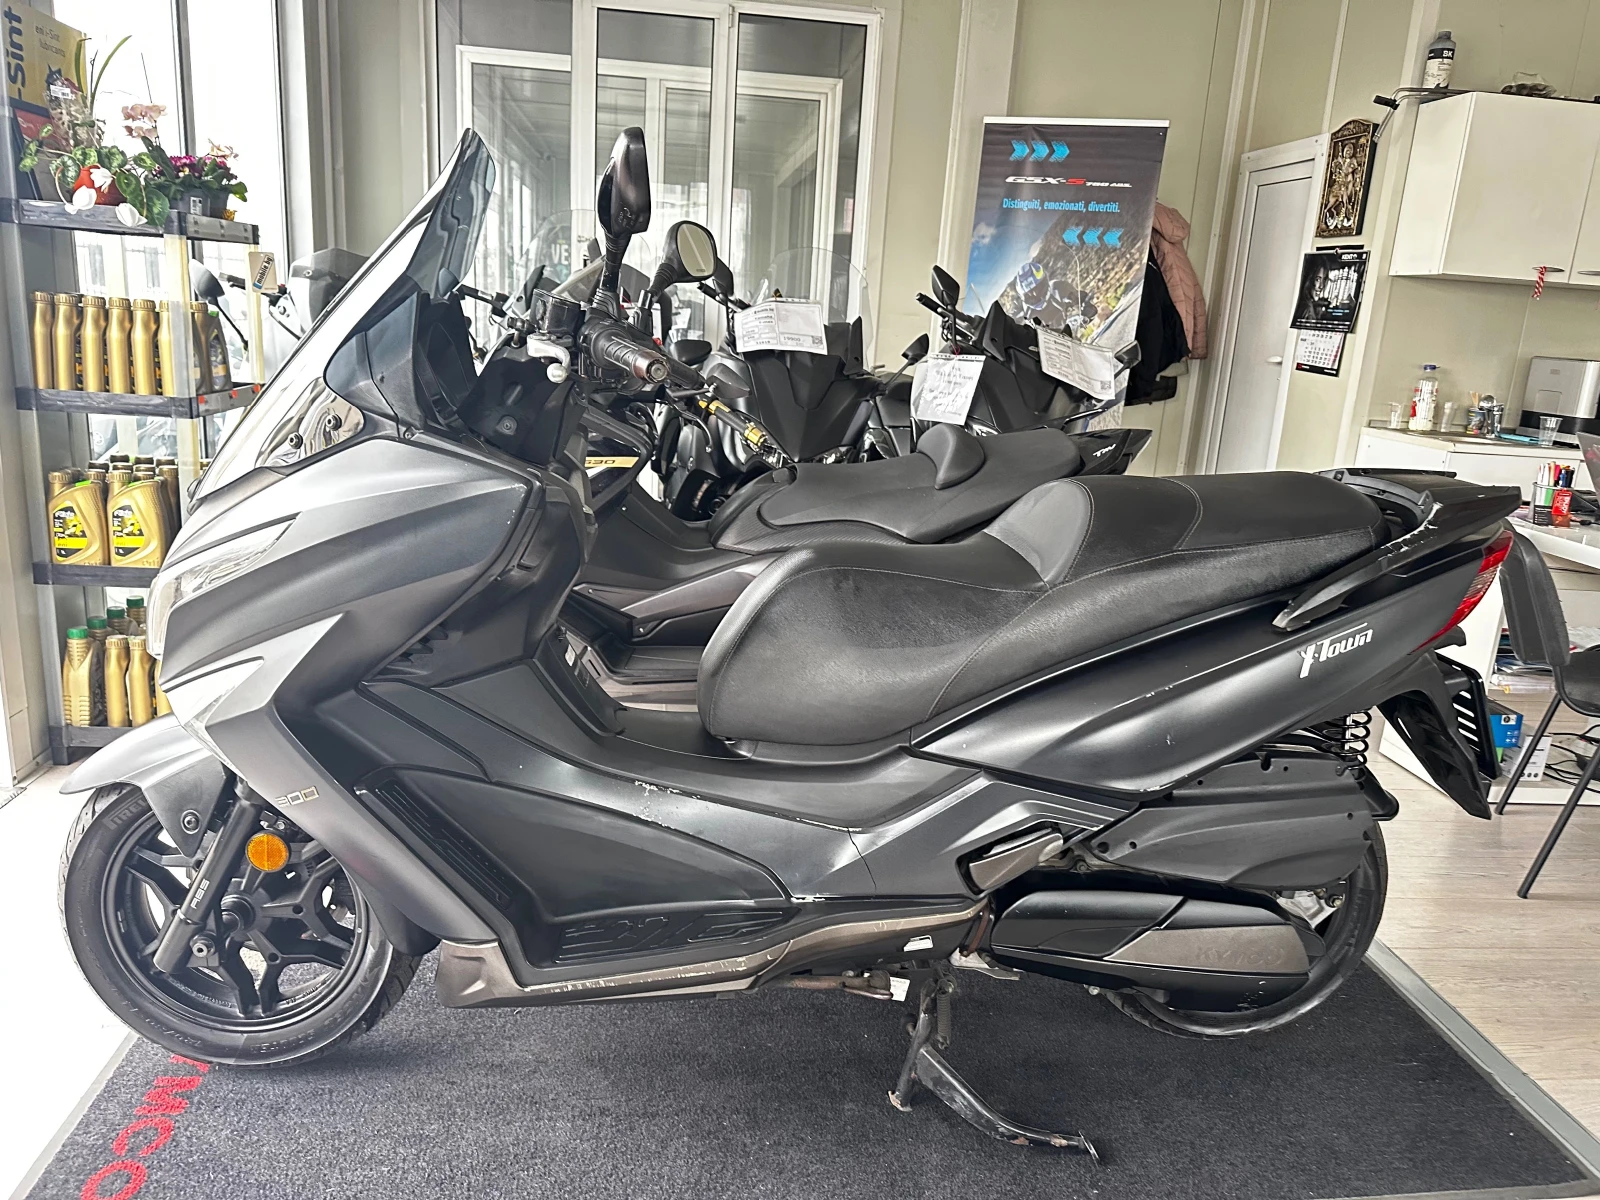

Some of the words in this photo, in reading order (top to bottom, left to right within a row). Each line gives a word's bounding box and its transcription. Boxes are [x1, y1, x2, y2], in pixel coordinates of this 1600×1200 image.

[1003, 198, 1042, 211] Distinguiti,
[1043, 199, 1086, 213] emozionati,
[1088, 200, 1121, 213] divertiti.
[275, 786, 320, 808] 300
[190, 878, 210, 909] ABS
